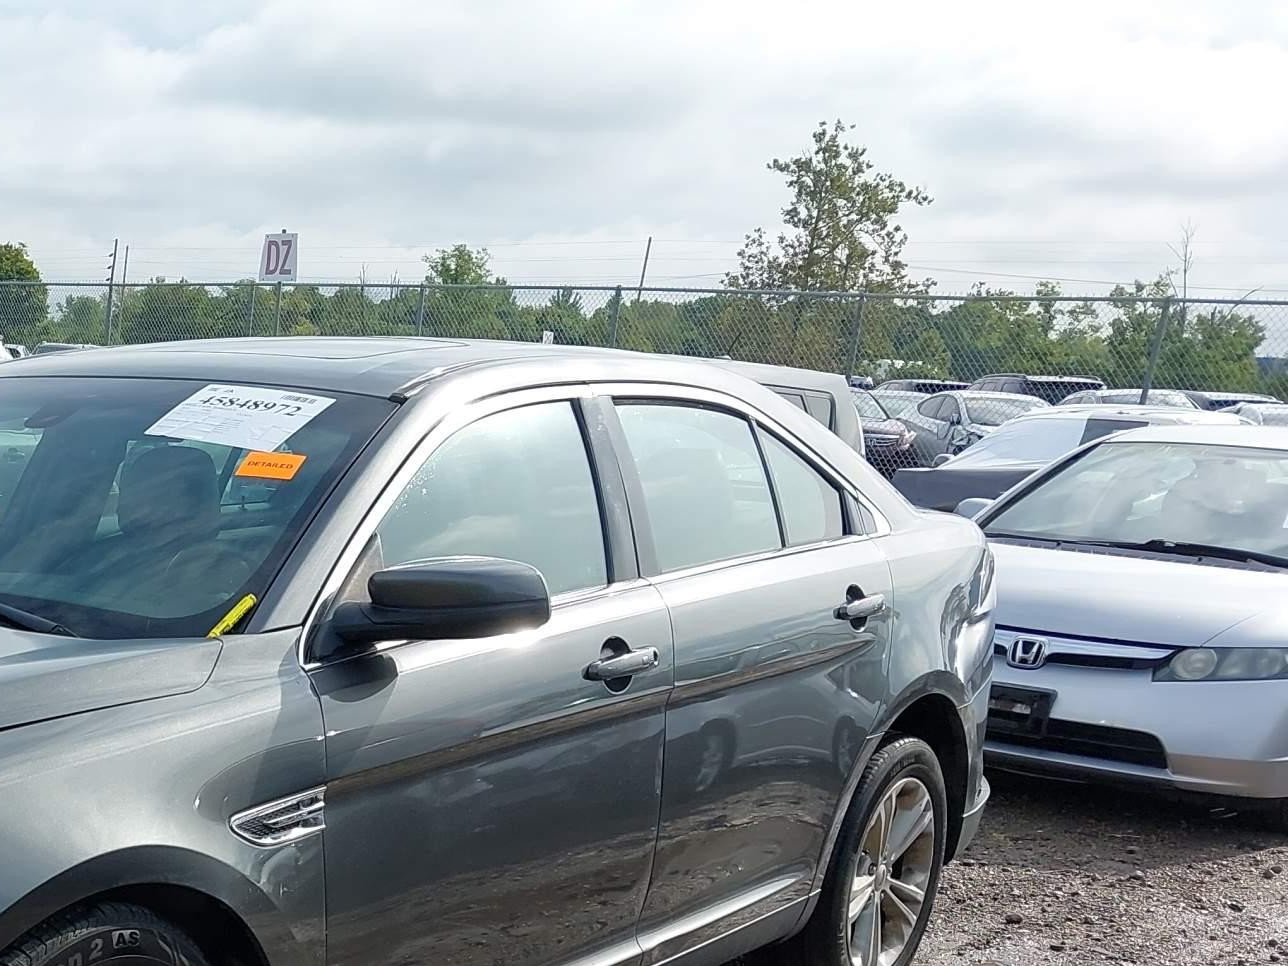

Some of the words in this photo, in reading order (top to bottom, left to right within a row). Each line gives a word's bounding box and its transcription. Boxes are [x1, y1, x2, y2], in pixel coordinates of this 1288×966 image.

[265, 240, 292, 275] DZ
[200, 396, 302, 416] 45848972
[247, 460, 293, 470] DETAILED
[89, 938, 104, 960] 2
[114, 930, 140, 948] AS
